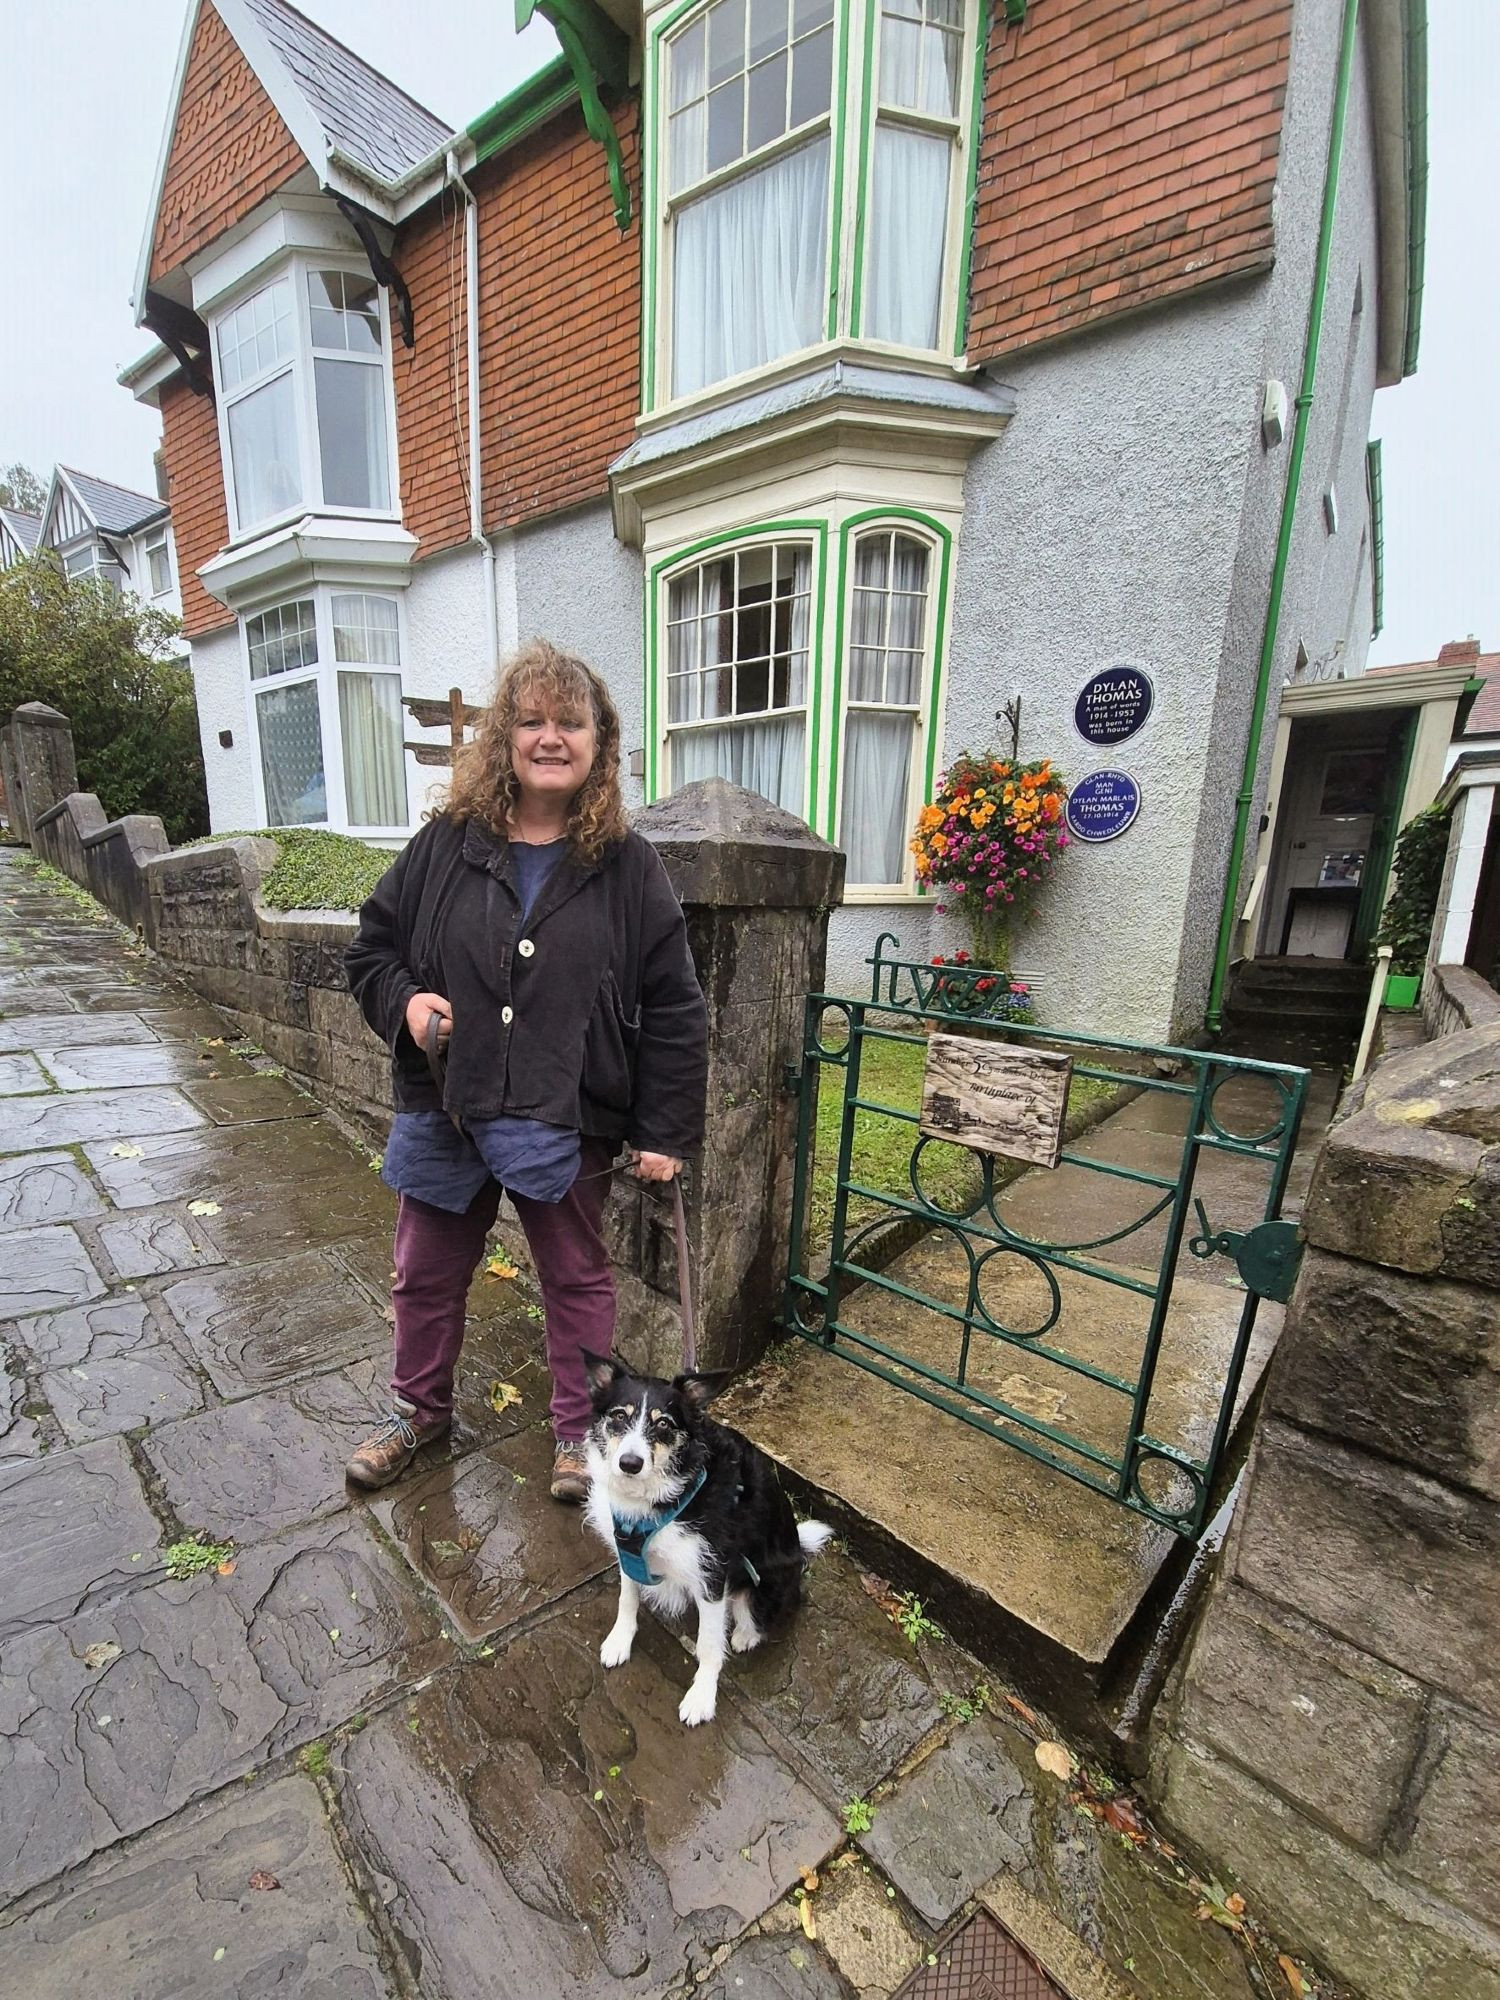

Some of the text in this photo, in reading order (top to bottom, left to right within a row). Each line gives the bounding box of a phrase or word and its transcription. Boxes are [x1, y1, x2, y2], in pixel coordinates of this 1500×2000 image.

[1093, 679, 1138, 694] DYLAN
[1085, 688, 1143, 705] THOMAS
[1090, 726, 1130, 735] this house
[1072, 794, 1135, 804] DYLAN MARLAIS
[1080, 803, 1124, 812] THOMAS
[1071, 814, 1086, 833] BARDD
[970, 1055, 987, 1075] 5
